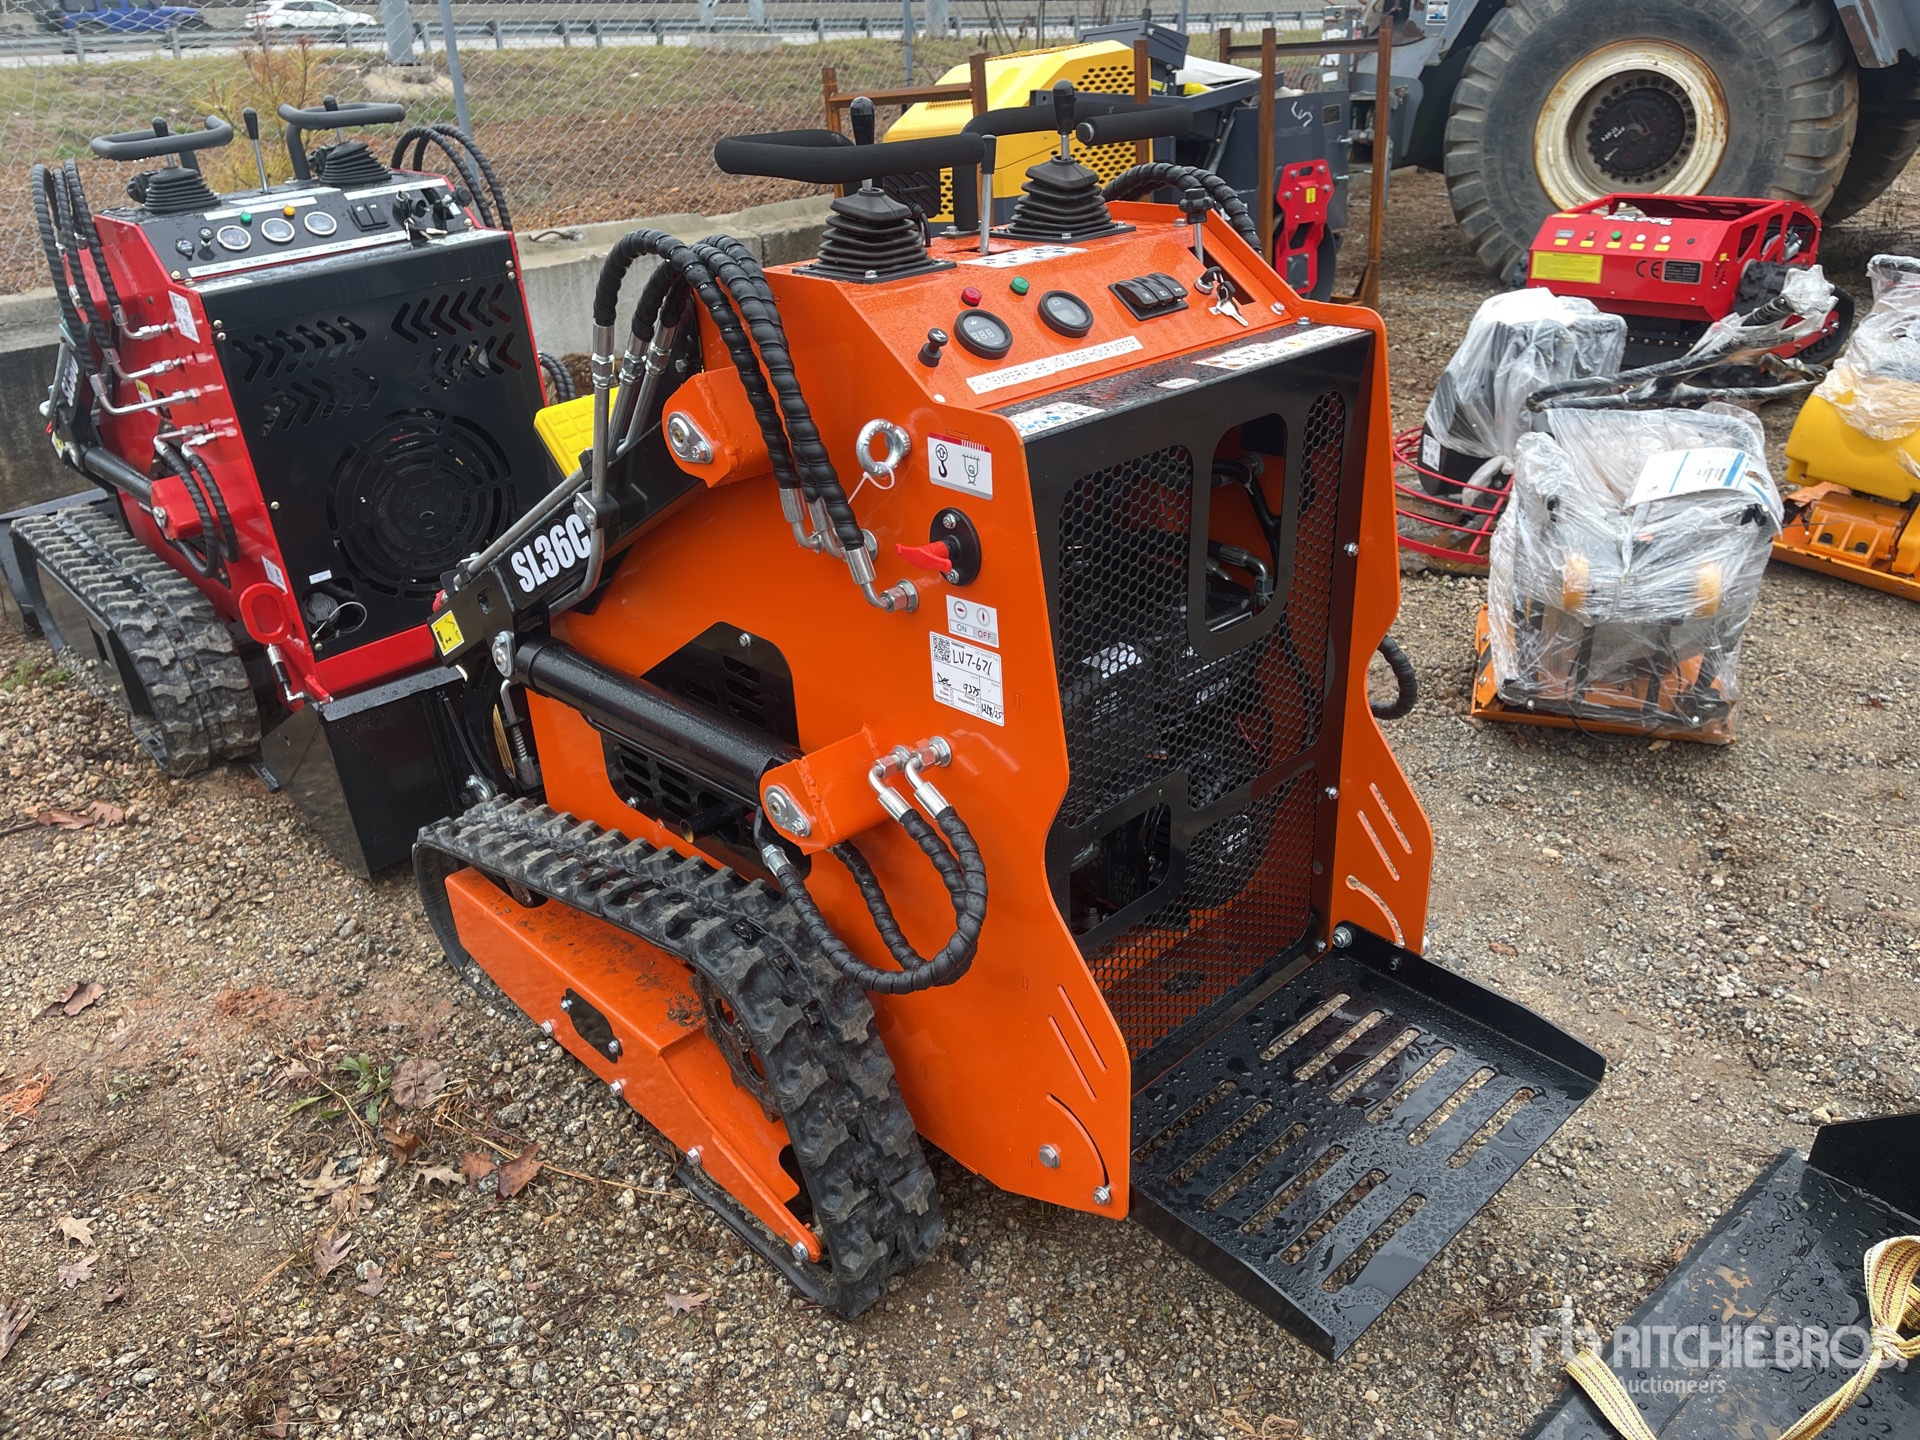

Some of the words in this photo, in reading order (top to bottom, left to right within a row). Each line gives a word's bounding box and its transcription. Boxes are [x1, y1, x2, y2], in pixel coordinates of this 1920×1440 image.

[1052, 350, 1090, 367] VOLTAGE
[1089, 344, 1110, 358] HOUR
[510, 513, 591, 593] SL36C
[956, 623, 967, 633] ON
[977, 630, 992, 641] OFF
[952, 649, 992, 676] LV7-671
